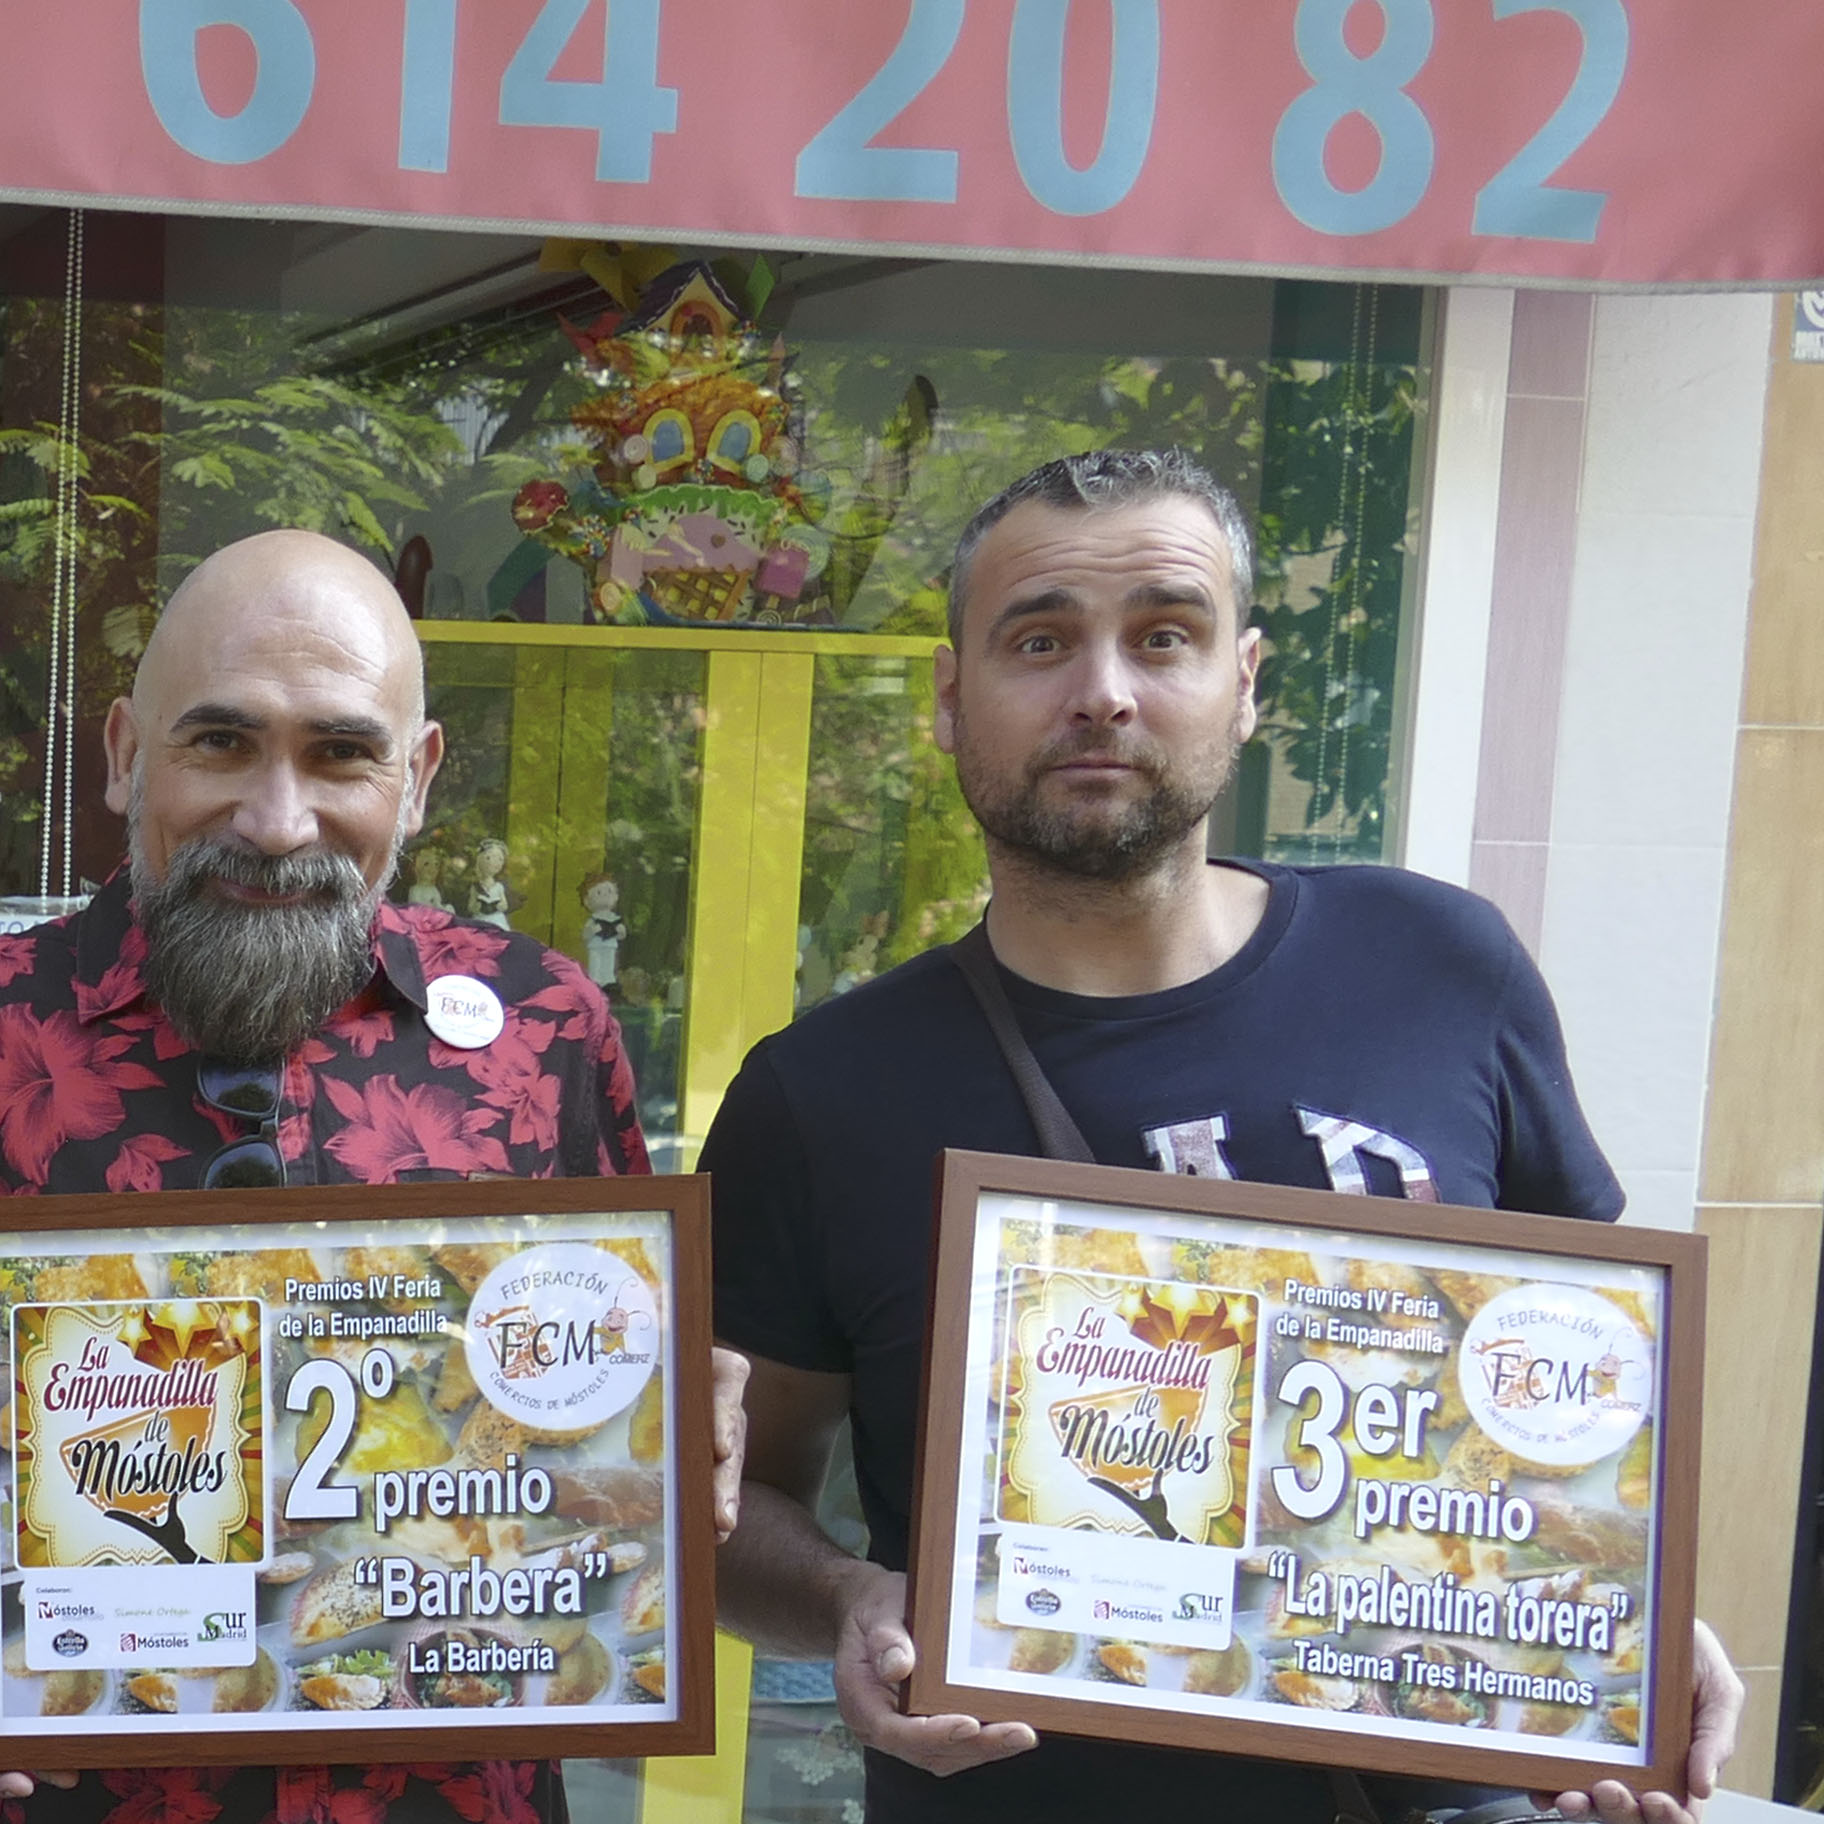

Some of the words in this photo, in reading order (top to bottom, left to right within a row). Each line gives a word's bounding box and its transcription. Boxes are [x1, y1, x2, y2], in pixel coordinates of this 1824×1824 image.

[140, 0, 679, 184] 614
[793, 0, 1160, 217] 20
[1271, 0, 1630, 243] 82
[285, 1276, 363, 1303] Premios
[368, 1276, 389, 1299] IV
[393, 1274, 441, 1299] Feria
[501, 1270, 608, 1301] FEDERACIÓN
[1284, 1279, 1362, 1310] Premios
[1367, 1290, 1388, 1312] IV
[1392, 1292, 1439, 1319] Feria
[279, 1315, 303, 1338] de
[308, 1314, 325, 1336] la
[330, 1310, 448, 1340] Empanadilla
[496, 1319, 596, 1369] FCM
[1073, 1306, 1106, 1339] La
[1276, 1313, 1300, 1337] de
[1305, 1316, 1322, 1340] la
[1326, 1319, 1444, 1354] Empanadilla
[78, 1337, 110, 1372] La
[1036, 1327, 1212, 1390] Empanadilla
[1491, 1352, 1589, 1406] FCM
[43, 1359, 218, 1422] Empanadilla
[1134, 1387, 1159, 1418] de
[144, 1410, 168, 1442] de
[1059, 1405, 1214, 1475] Móstoles
[1271, 1359, 1439, 1520] 3er
[72, 1438, 227, 1501] Móstoles
[374, 1454, 551, 1533] premio
[1354, 1478, 1534, 1542] premio
[354, 1553, 608, 1619] “Barbera”
[1268, 1551, 1329, 1617] “La
[1336, 1564, 1496, 1637] palentina
[1505, 1582, 1629, 1651] torera”
[1111, 1606, 1164, 1623] Móstoles
[137, 1636, 189, 1649] Móstoles
[409, 1643, 440, 1674] La
[447, 1637, 555, 1674] Barbería
[1294, 1640, 1395, 1682] Taberna
[1402, 1653, 1456, 1690] Tres
[1464, 1661, 1594, 1707] Hermanos
